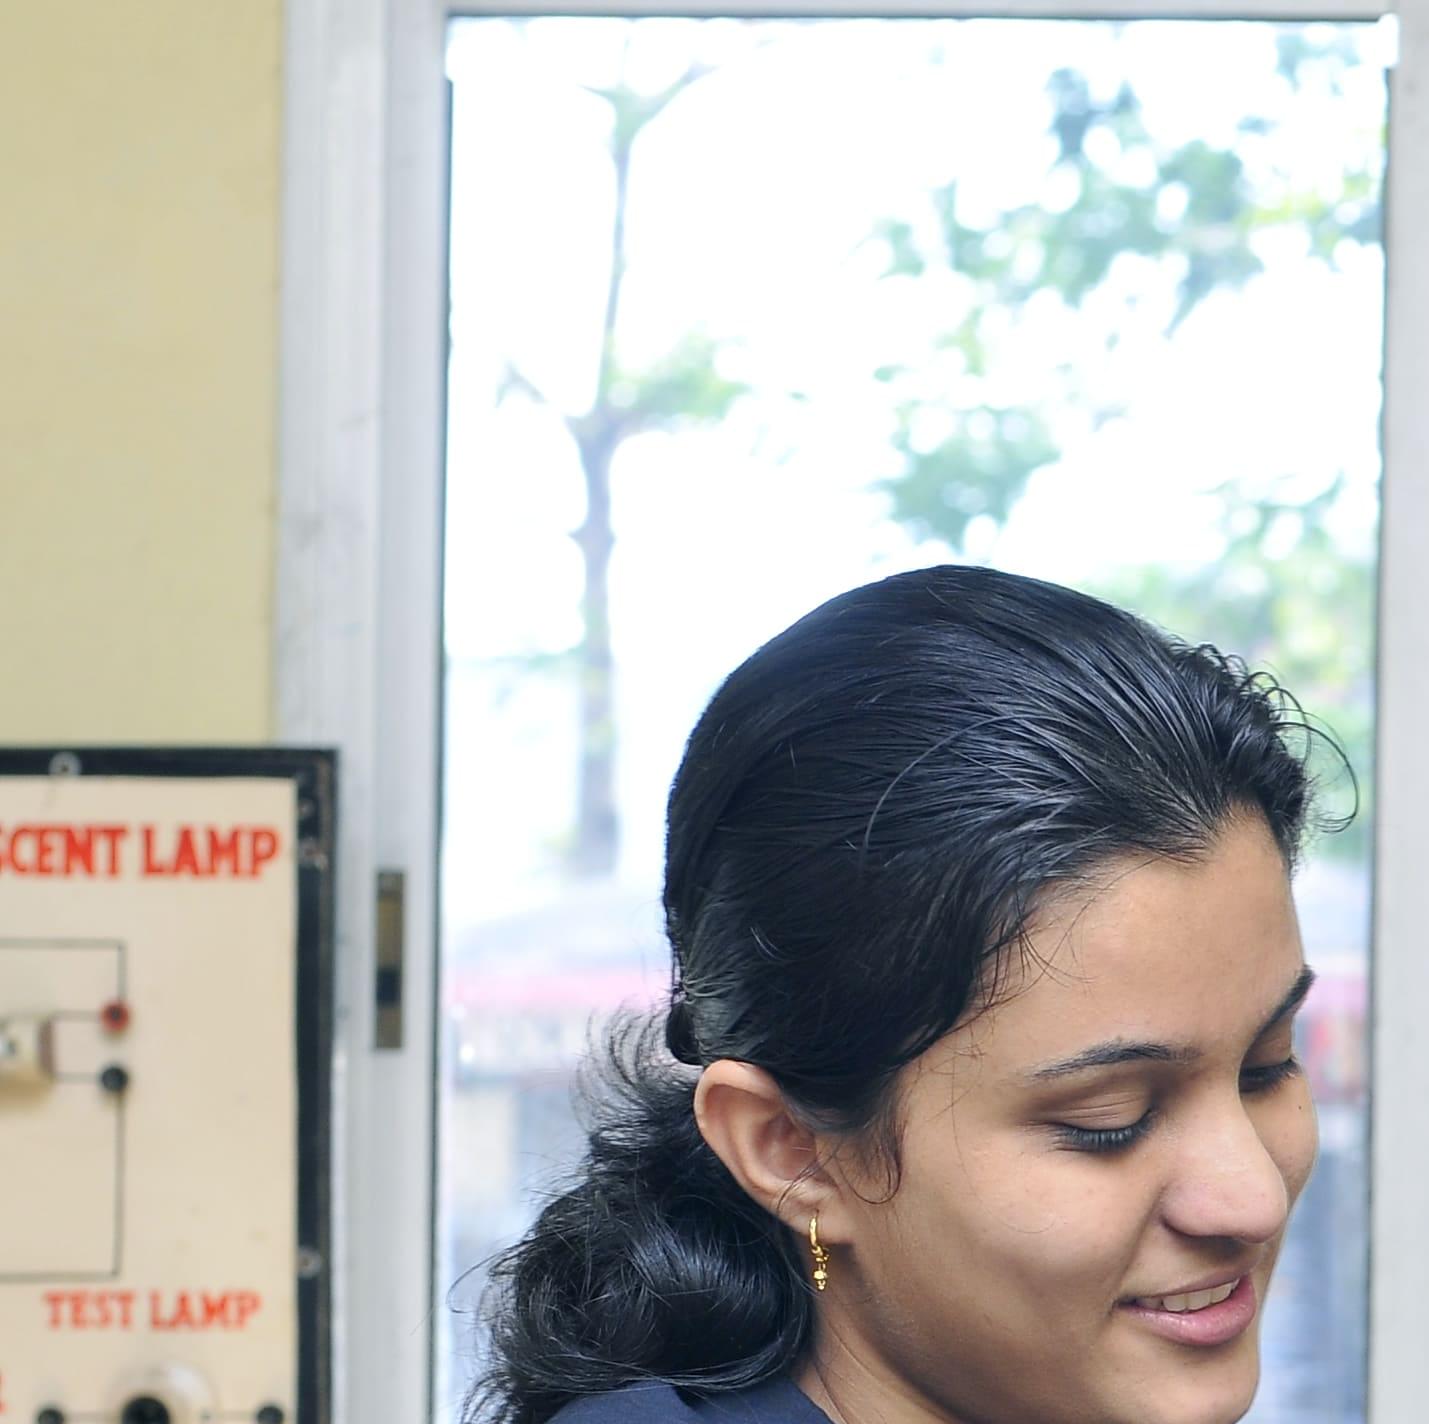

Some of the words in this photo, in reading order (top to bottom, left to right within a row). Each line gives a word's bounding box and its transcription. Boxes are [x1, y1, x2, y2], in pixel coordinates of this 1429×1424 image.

[142, 824, 280, 877] LAMP
[45, 1289, 135, 1330] TEST
[149, 1290, 262, 1333] LAMP
